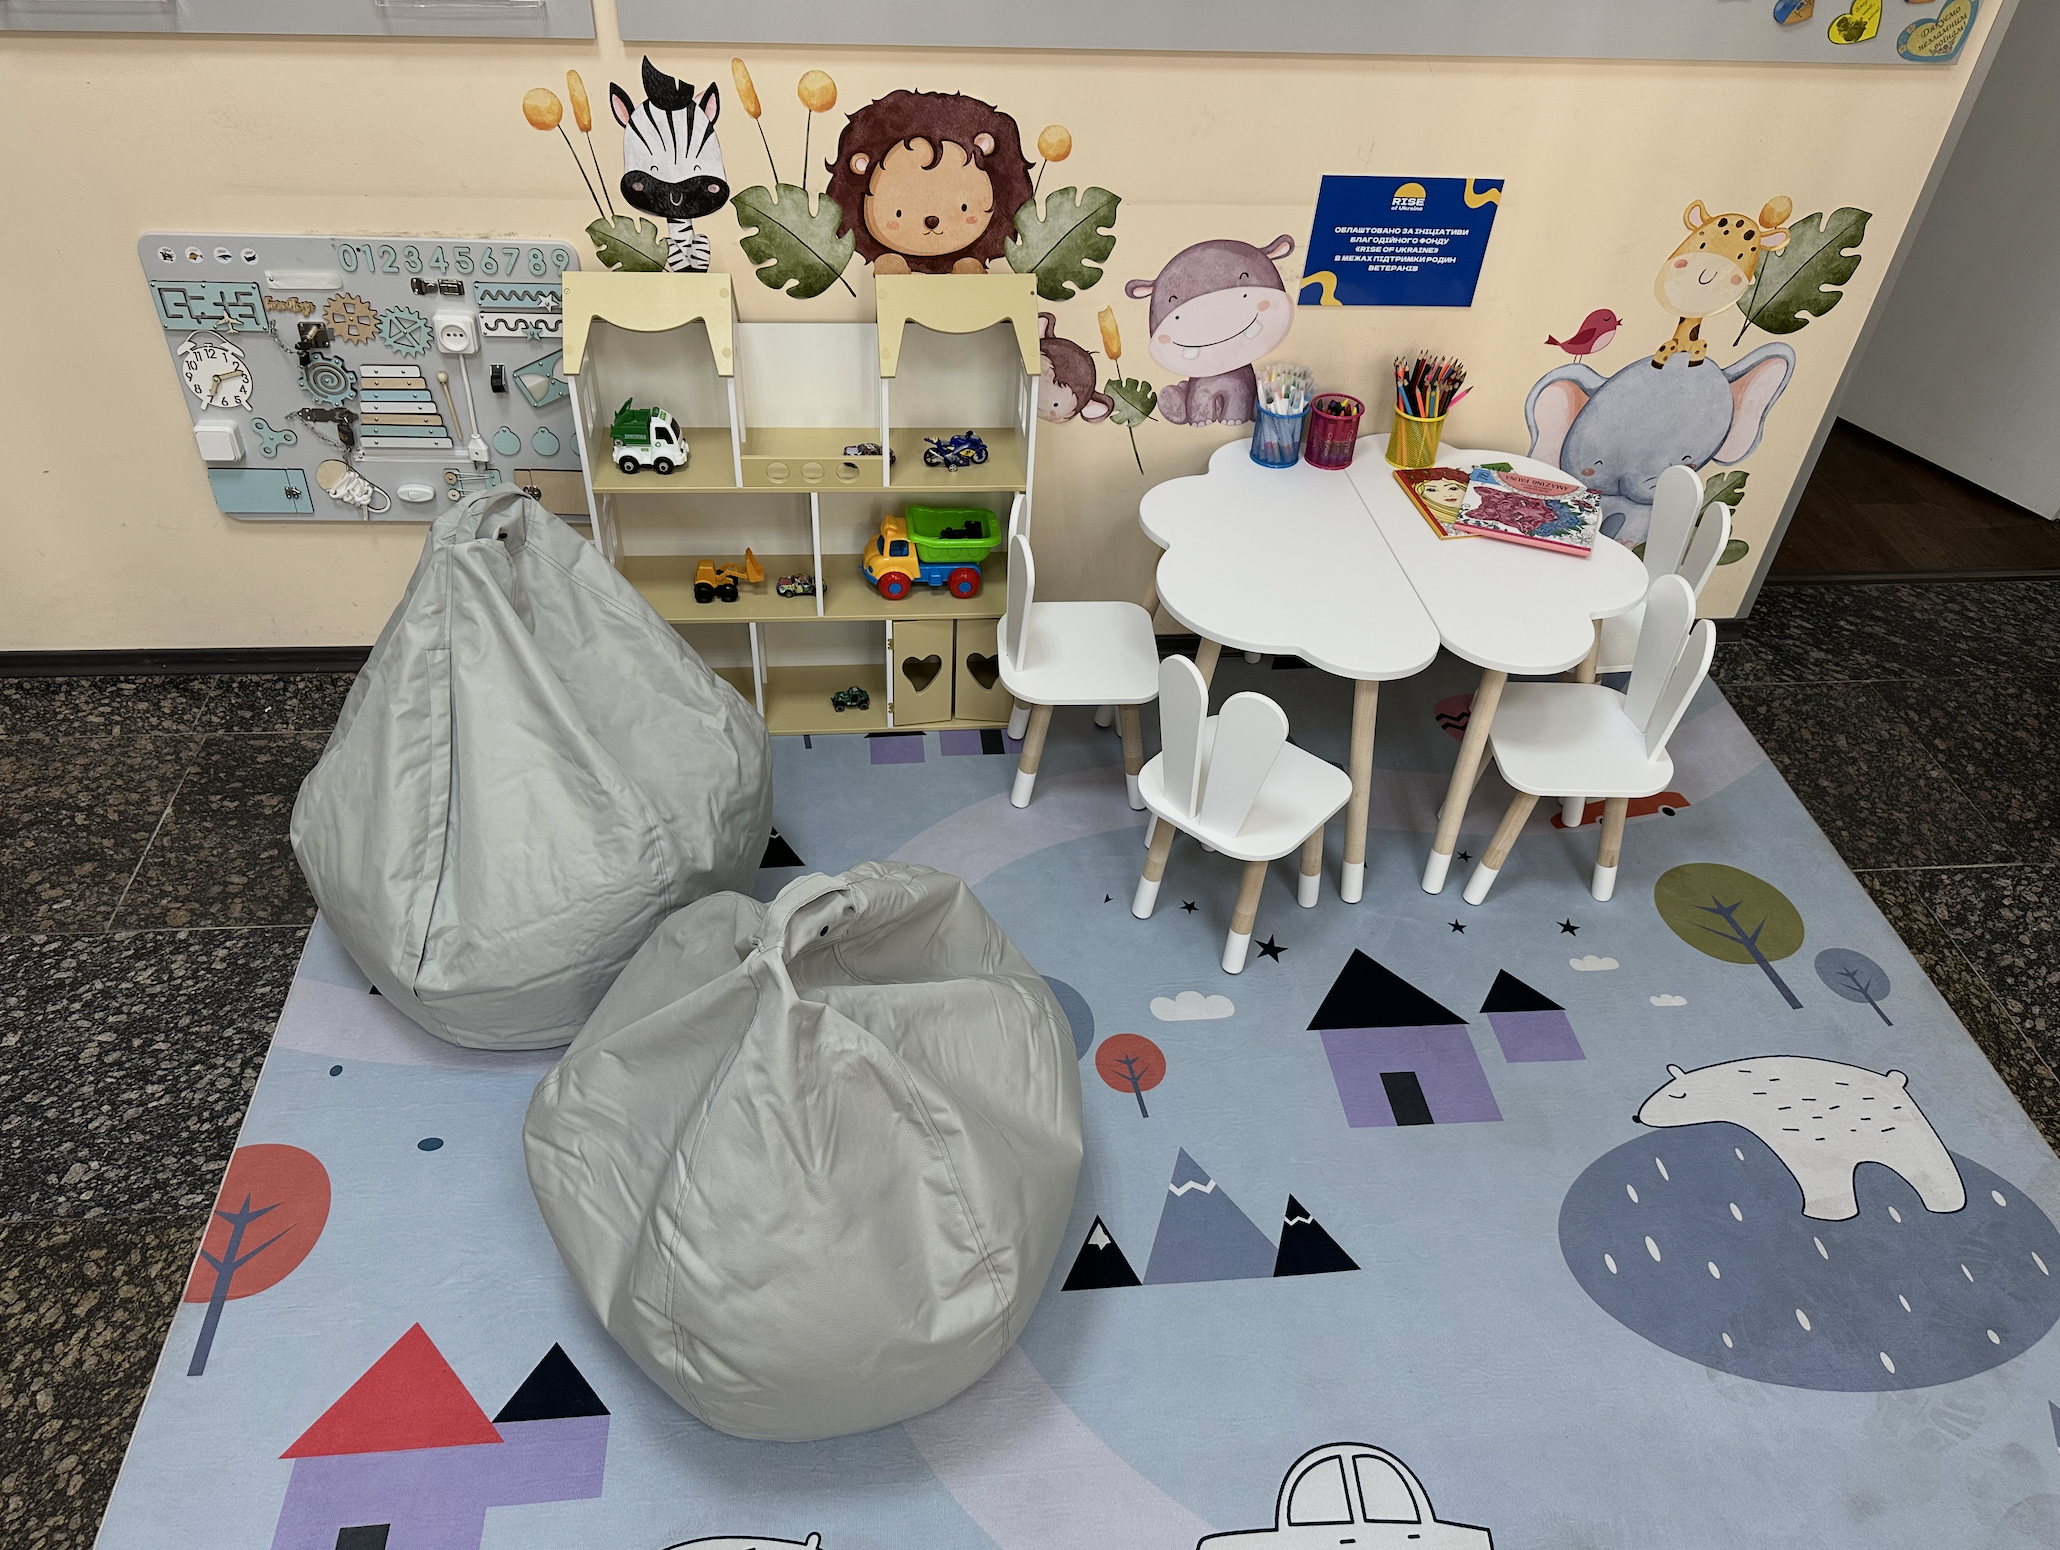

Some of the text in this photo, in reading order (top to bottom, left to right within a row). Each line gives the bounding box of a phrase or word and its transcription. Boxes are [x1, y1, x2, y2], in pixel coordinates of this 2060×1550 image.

[1918, 13, 1967, 52] незламним
[1392, 197, 1426, 206] RISE
[1334, 226, 1470, 236] ОБЛАШТОВАНО ЗА ІНІЦІАТИВИ
[1349, 236, 1450, 246] БЛАГОДІЙНОГО ФОНДУ
[1334, 254, 1341, 262] В
[1372, 255, 1426, 263] ПІДТРИМКИ
[1425, 256, 1457, 264] РОДИН
[1367, 264, 1419, 272] ВЕТЕРАНІВ
[204, 348, 218, 359] 12
[222, 352, 229, 363] 1
[185, 360, 198, 371] 10
[185, 371, 193, 382] 9
[241, 373, 250, 384] 3
[193, 383, 202, 394] 8
[239, 384, 248, 395] 4
[221, 396, 229, 407] 6
[233, 395, 242, 404] 5
[1505, 474, 1530, 484] FAUNA
[1531, 479, 1570, 491] AMAZING
